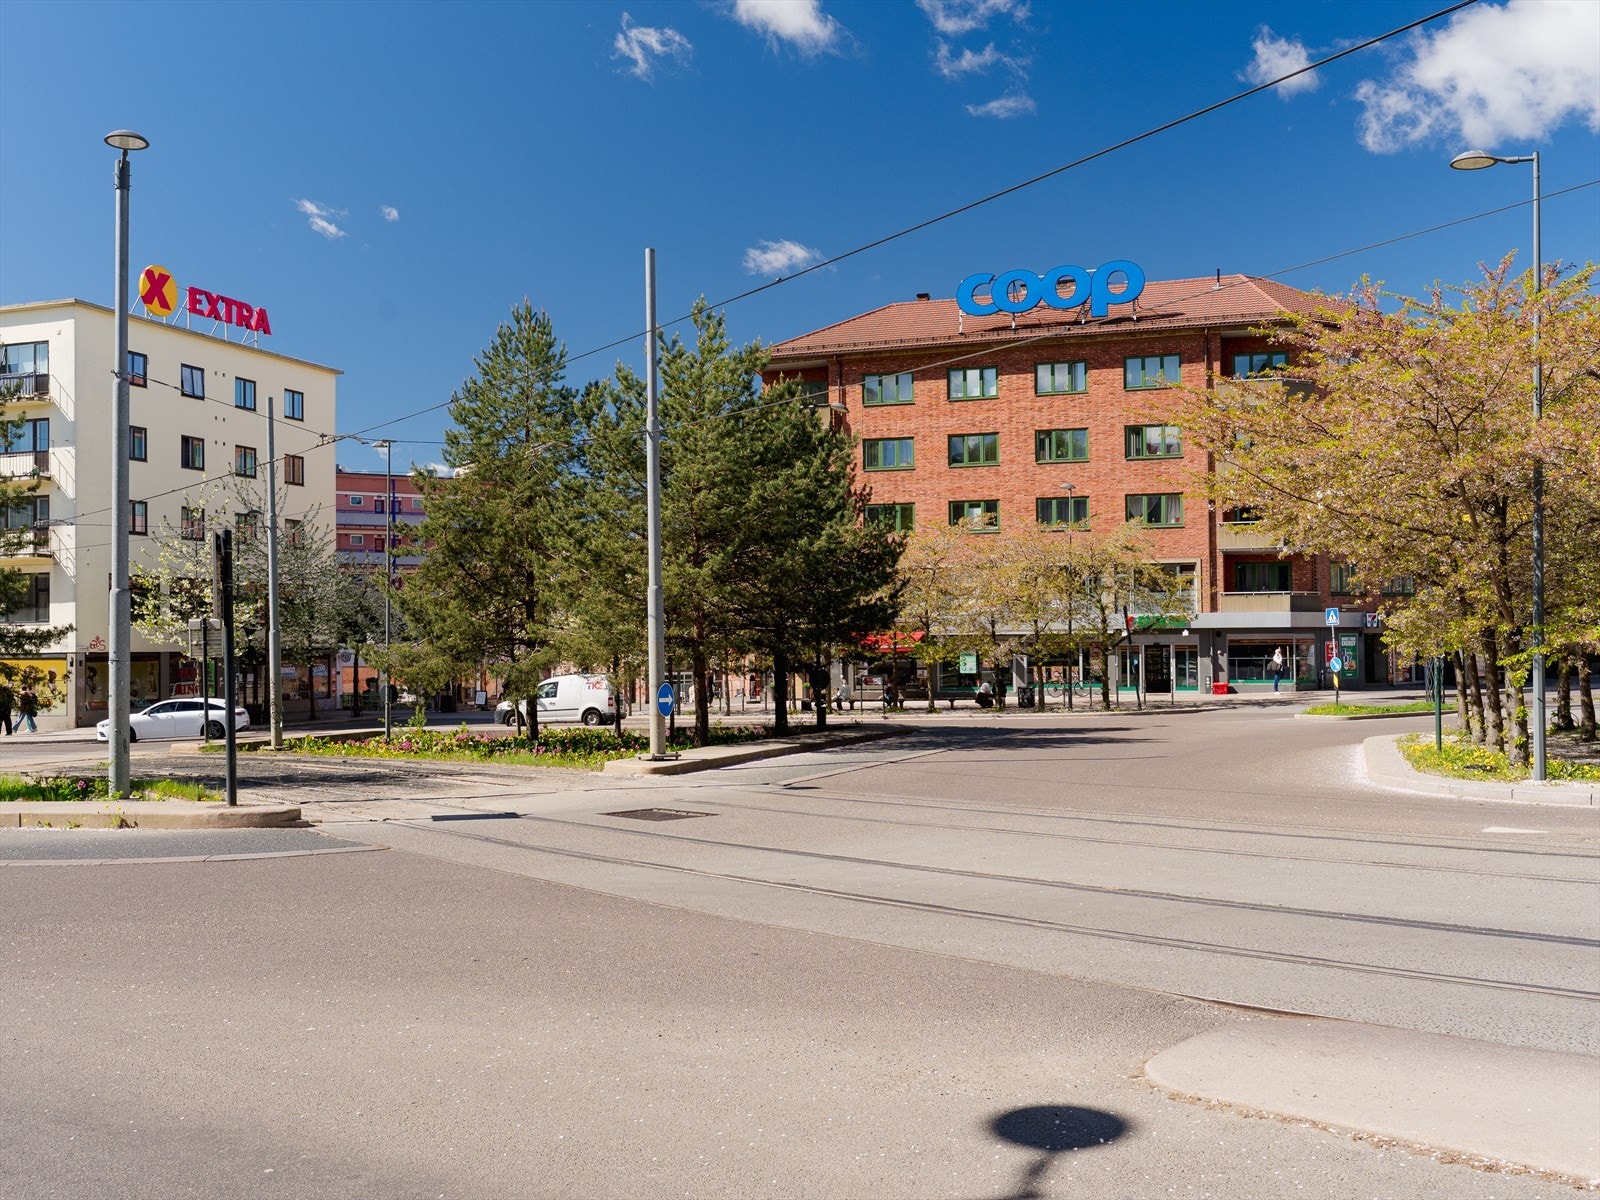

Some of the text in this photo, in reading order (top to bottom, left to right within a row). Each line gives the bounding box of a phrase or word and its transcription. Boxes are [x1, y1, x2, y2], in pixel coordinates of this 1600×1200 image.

[141, 269, 272, 336] X EXTRA
[956, 260, 1145, 317] coop
